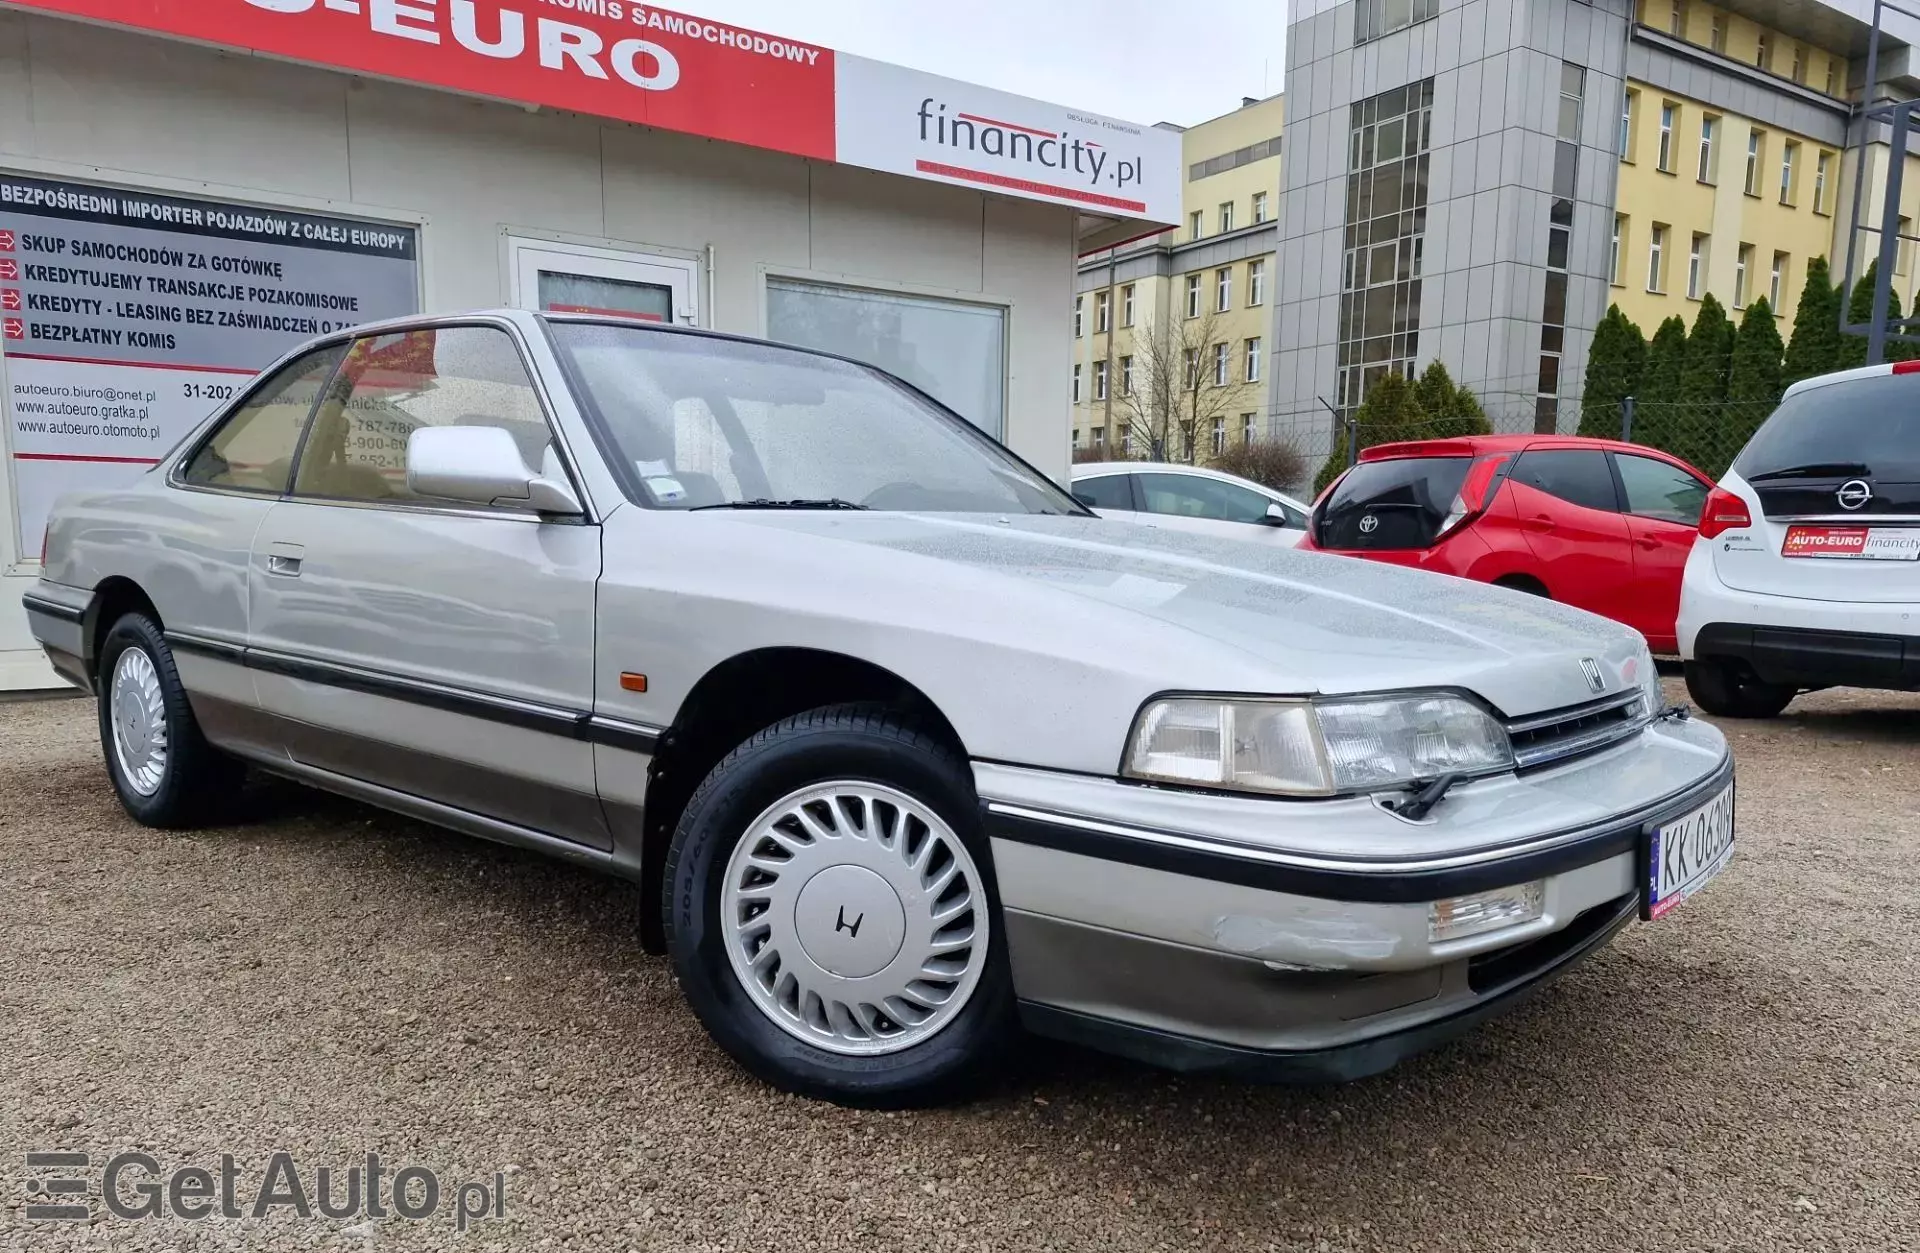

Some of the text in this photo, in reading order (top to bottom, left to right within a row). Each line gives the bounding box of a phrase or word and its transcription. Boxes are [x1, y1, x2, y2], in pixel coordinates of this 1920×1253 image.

[632, 7, 819, 66] SAMOCHODOWY
[917, 97, 1142, 188] financity.pl
[1, 184, 405, 250] BEZPOŚREDNI IMPORTER POJAZDÓW Z CAŁEJ EUROPY
[21, 234, 283, 281] SKUP SAMOCHODÓW ZA GOTÓWKĘ
[24, 263, 358, 312] KREDYTUJEMY TRANSAKCJE POZAKOMISOWE
[27, 293, 102, 316] KREDYTY
[116, 302, 182, 323] LEASING
[186, 308, 214, 325] BEZ
[218, 310, 318, 334] ZAŚWIADCZEŃ
[322, 321, 331, 335] O
[30, 323, 176, 350] BEZPŁATNY KOMIS
[14, 383, 233, 402] autoeuro.biuro@onet.pl 31-202
[15, 401, 149, 421] www.autoeuro.gratka.pl
[18, 421, 160, 439] www.autoeuro.otomoto.pl
[1791, 534, 1863, 547] AUTO-EURO
[1664, 820, 1691, 891] KK
